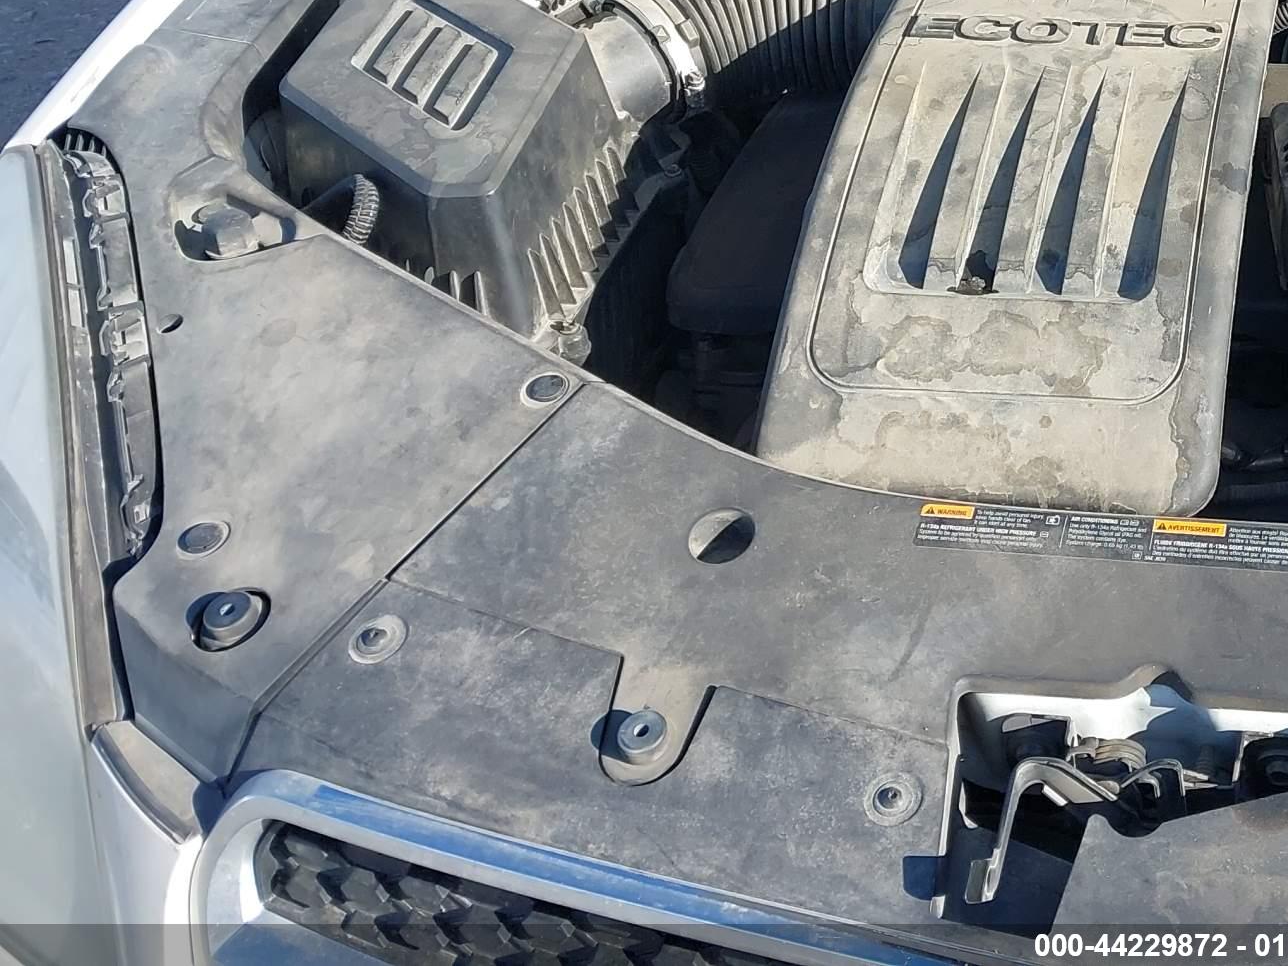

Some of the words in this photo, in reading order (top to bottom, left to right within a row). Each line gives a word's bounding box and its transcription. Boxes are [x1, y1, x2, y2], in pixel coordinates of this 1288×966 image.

[902, 15, 1223, 49] ECOTEC
[940, 524, 976, 532] REFRIGERANT
[1168, 525, 1220, 533] AVERTISSEMENT
